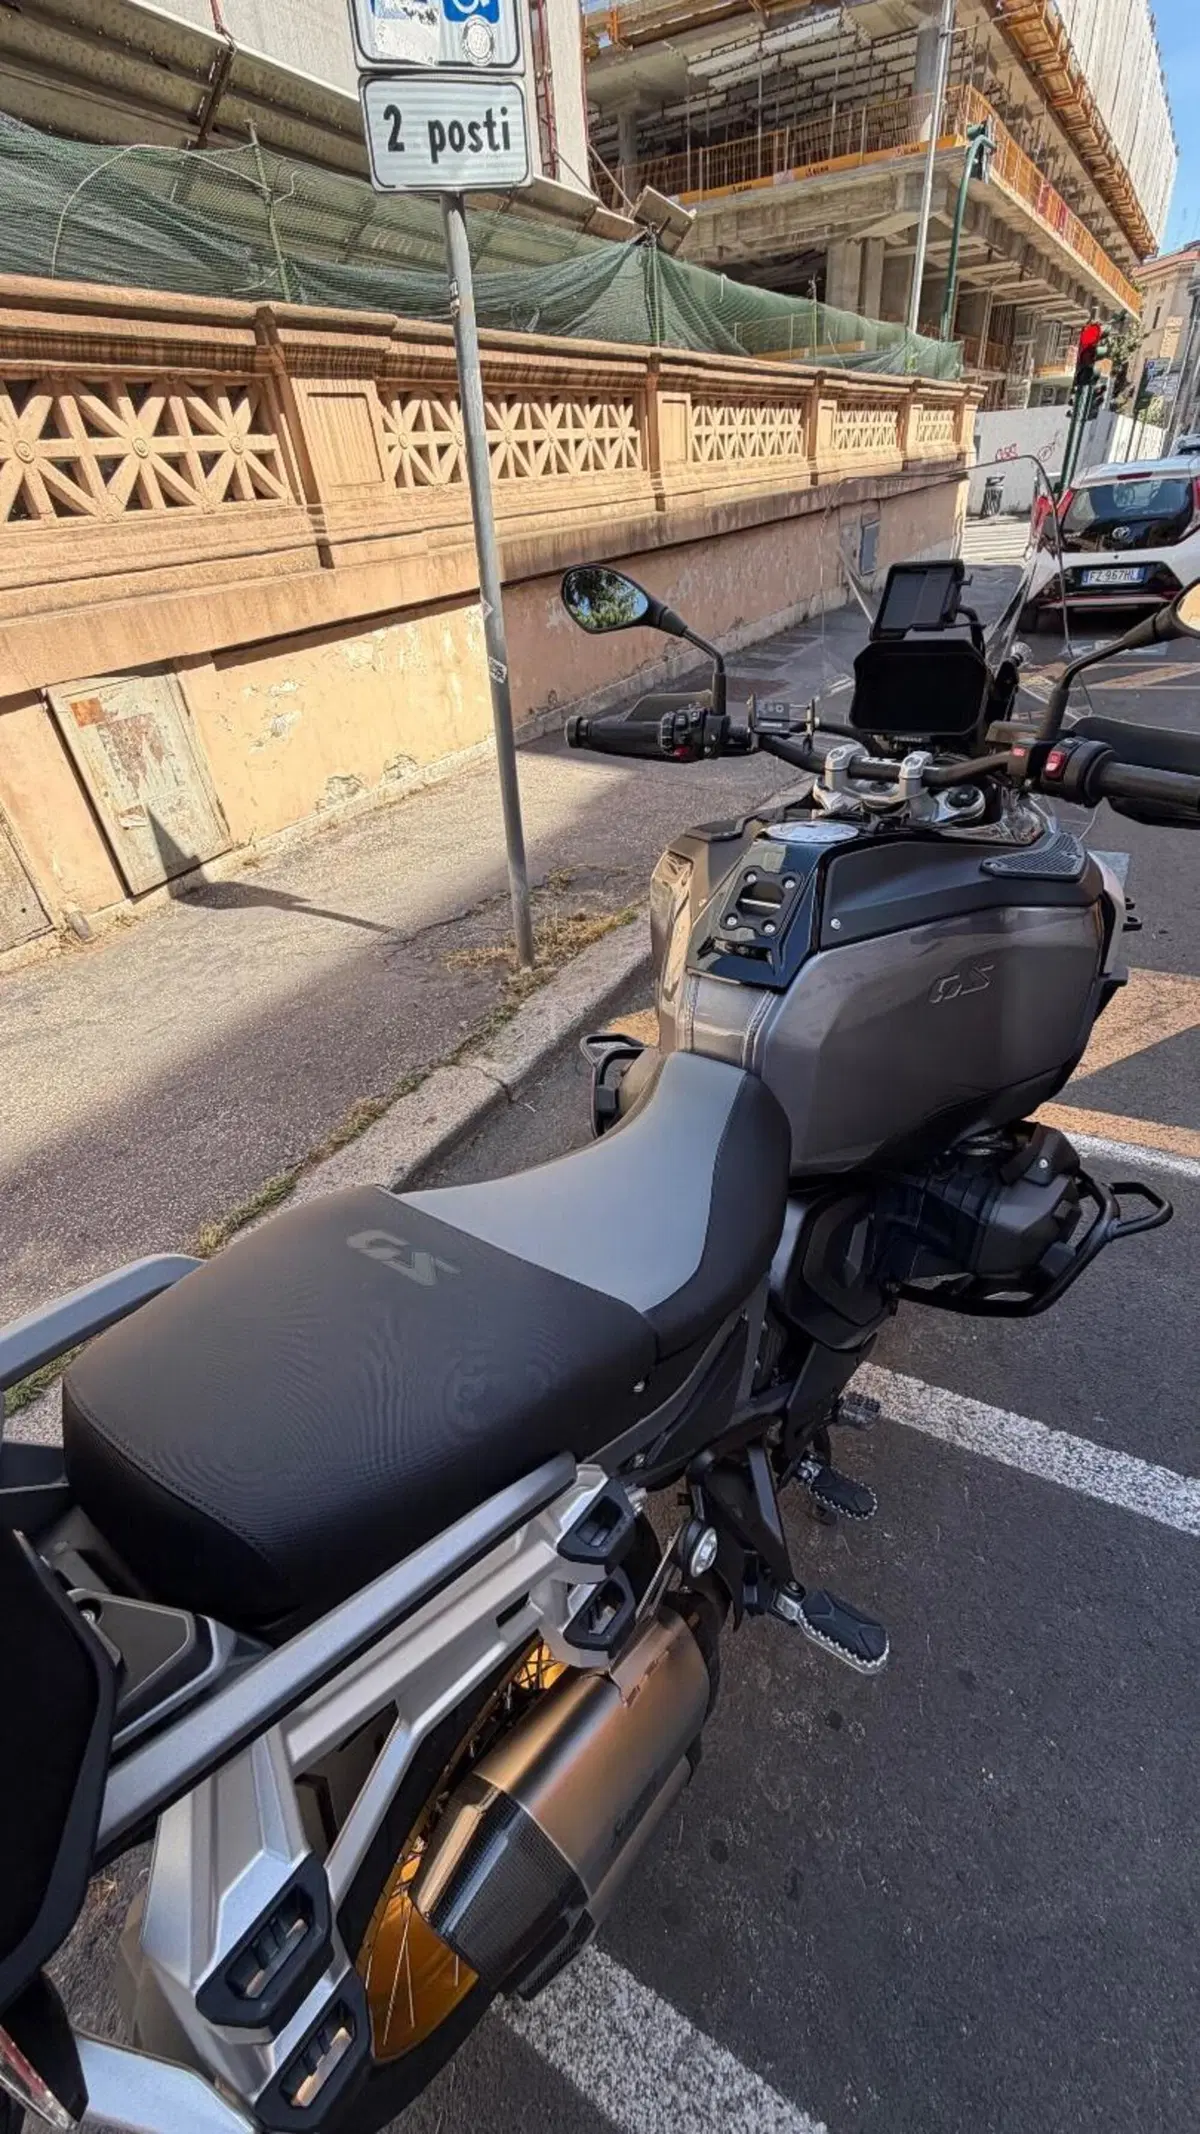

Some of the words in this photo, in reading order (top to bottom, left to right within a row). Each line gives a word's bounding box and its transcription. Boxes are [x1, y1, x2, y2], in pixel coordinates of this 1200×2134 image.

[383, 103, 405, 153] 2
[427, 106, 511, 164] posti
[928, 965, 996, 1004] GS
[346, 1229, 462, 1287] GS
